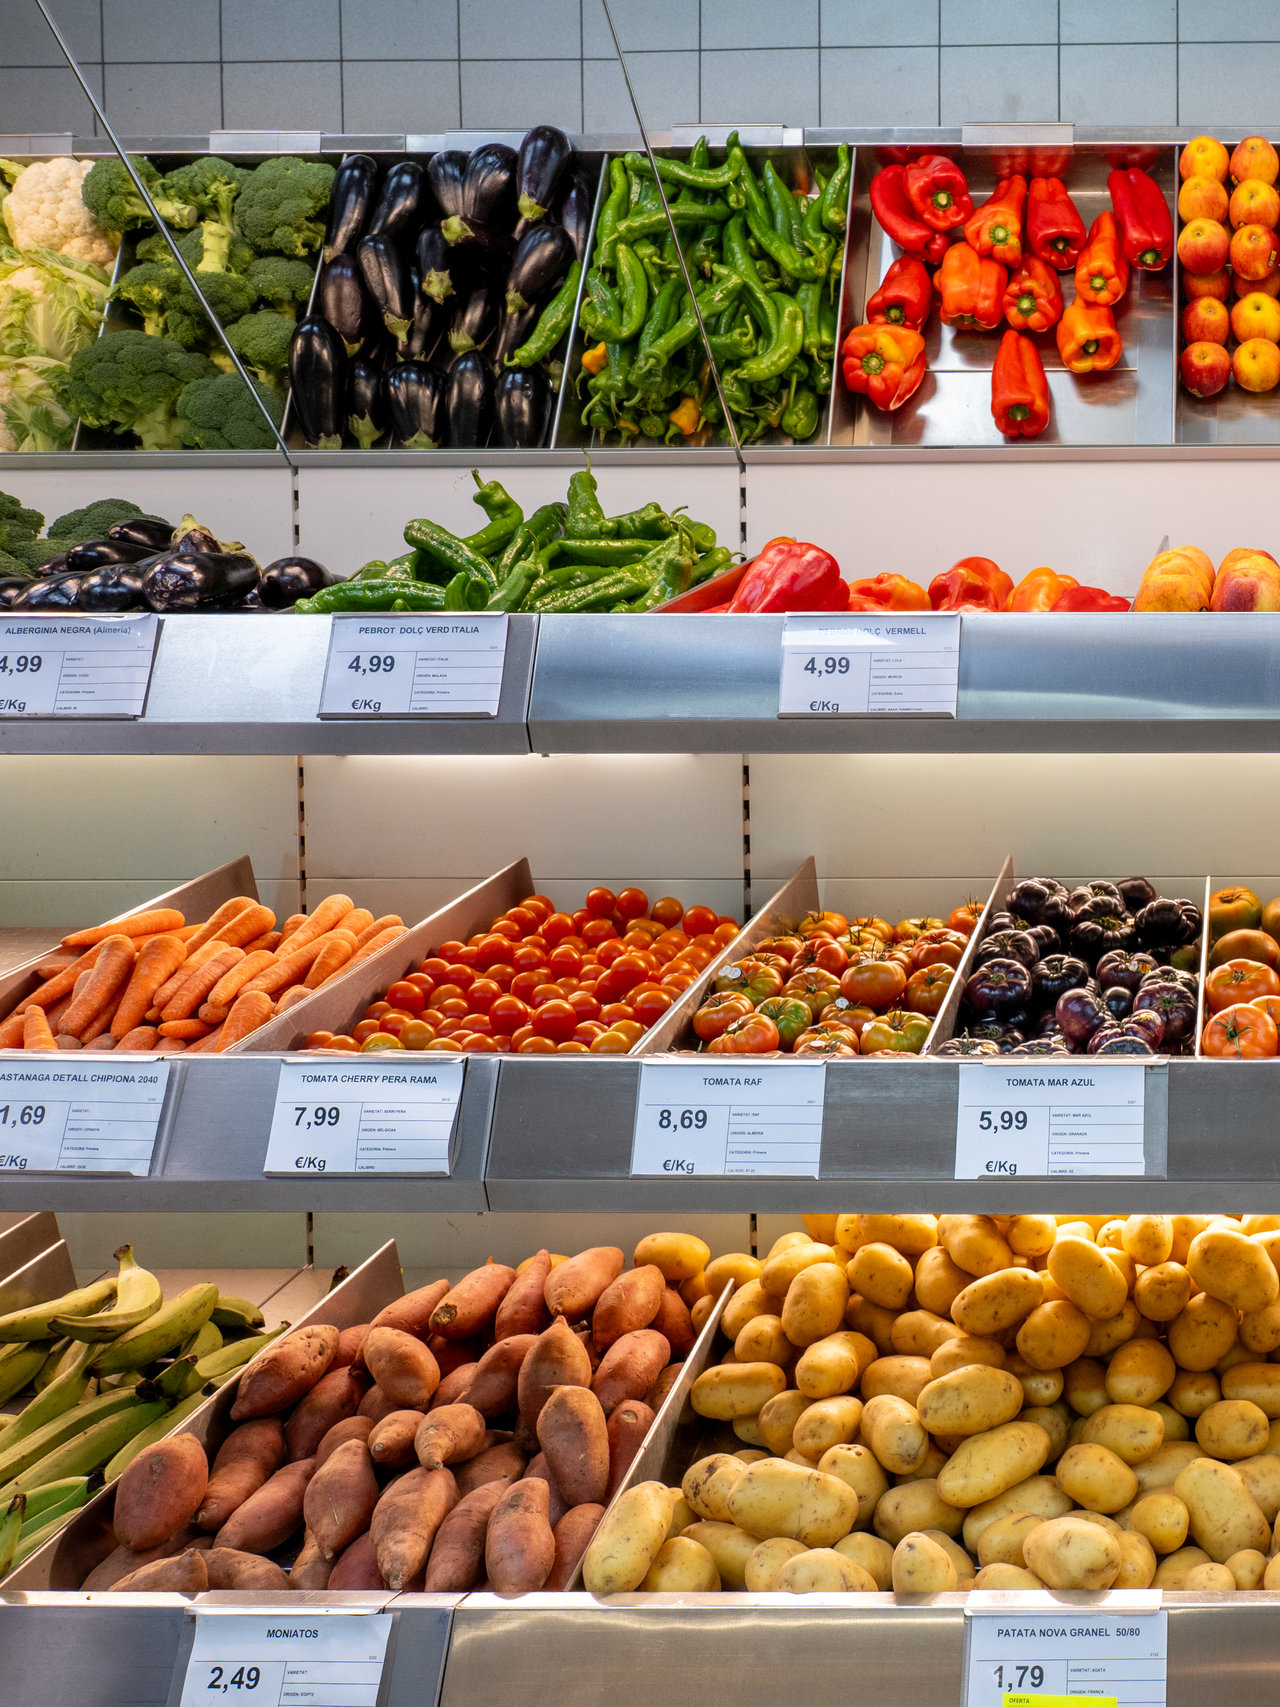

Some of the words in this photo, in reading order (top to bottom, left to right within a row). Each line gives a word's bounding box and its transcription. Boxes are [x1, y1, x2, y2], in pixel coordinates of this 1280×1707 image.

[94, 627, 131, 635] (Almeria)
[857, 628, 880, 636] OLÇ
[348, 655, 395, 675] 4,99
[804, 657, 850, 677] 4,99
[351, 699, 381, 712] €/Kg
[810, 701, 839, 712] €/Kg
[91, 1075, 135, 1083] CHIPIONA
[301, 1075, 338, 1083] TOMATA
[341, 1075, 379, 1083] CHERRY
[382, 1075, 407, 1083] PERA
[410, 1076, 437, 1084] RAMA
[703, 1078, 741, 1086] TOMATA
[744, 1078, 762, 1086] RAF
[1007, 1079, 1045, 1087] TOMATA
[1048, 1079, 1069, 1087] MAR
[0, 1105, 46, 1128] 1,69
[295, 1106, 340, 1130] 7,99
[658, 1109, 707, 1132] 8,69
[979, 1111, 1028, 1133] 5,99
[295, 1156, 326, 1171] €/Kg
[663, 1160, 695, 1174] €/Kg
[985, 1161, 1017, 1175] €/Kg
[267, 1629, 319, 1638] MONIATOS
[997, 1628, 1036, 1638] PATATA
[1039, 1628, 1067, 1637] NOVA
[1069, 1628, 1111, 1637] GRANEL
[1116, 1628, 1140, 1637] 50/80
[208, 1666, 261, 1693] 2,49
[993, 1665, 1044, 1692] 1,79
